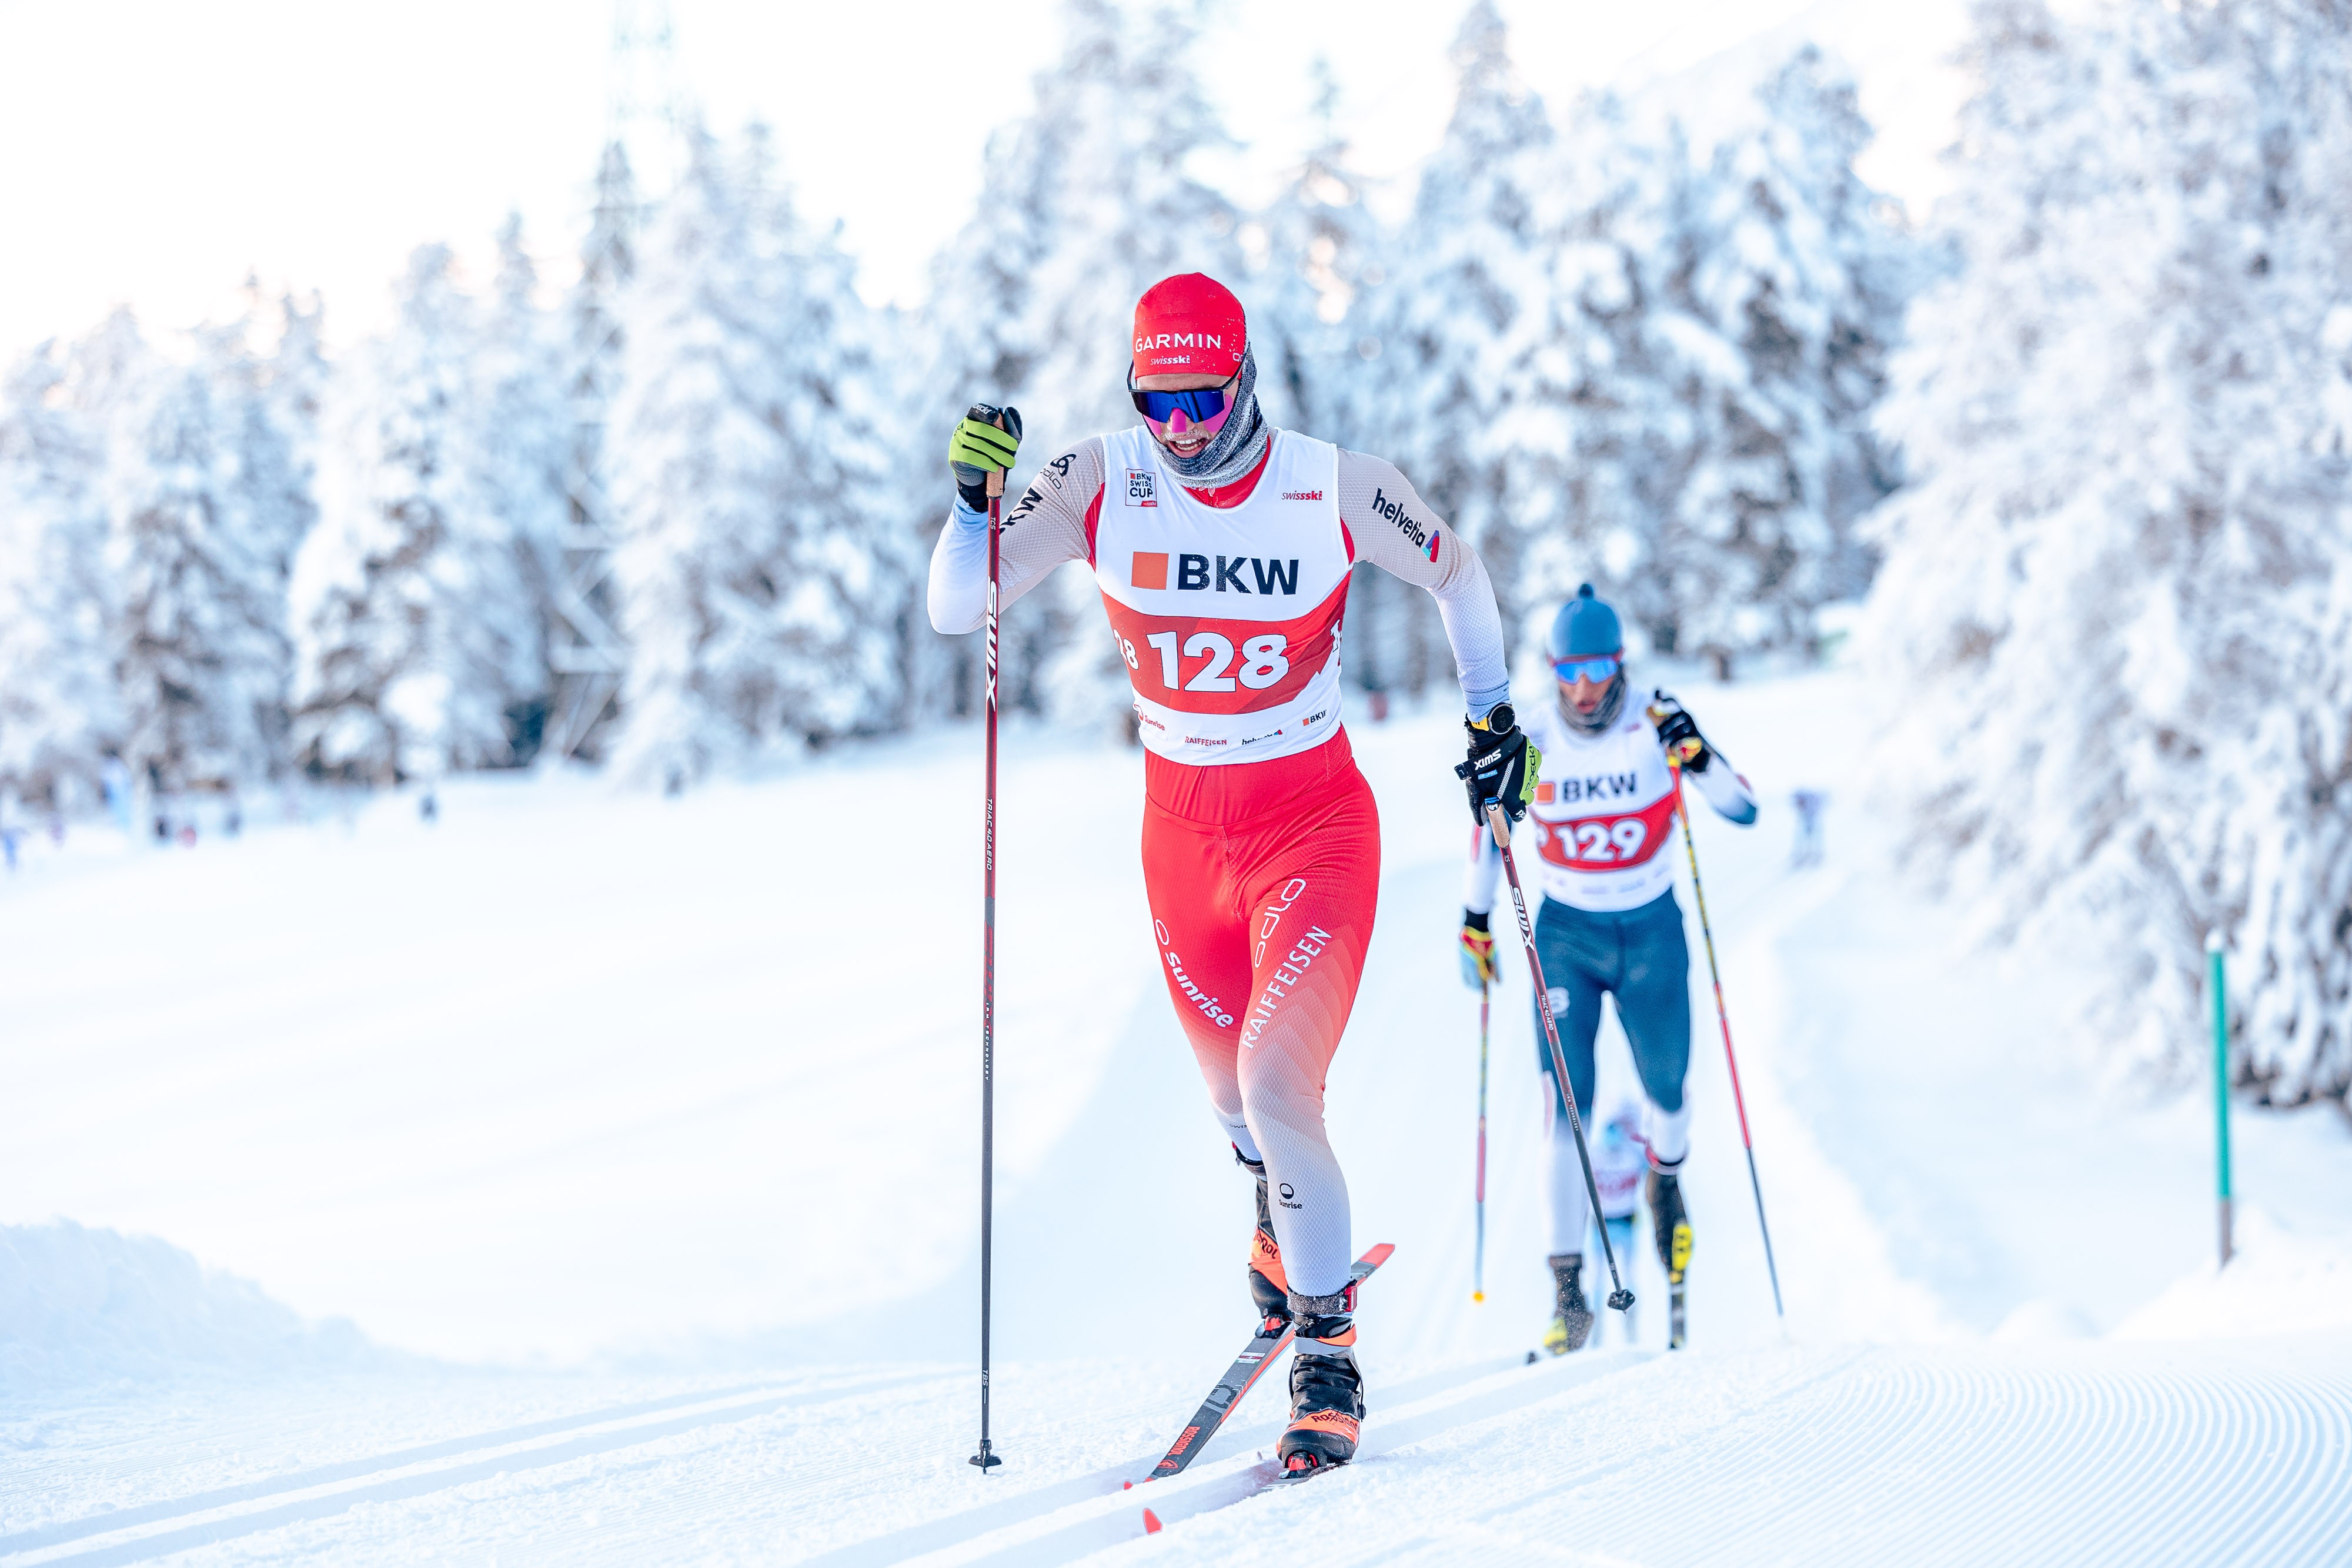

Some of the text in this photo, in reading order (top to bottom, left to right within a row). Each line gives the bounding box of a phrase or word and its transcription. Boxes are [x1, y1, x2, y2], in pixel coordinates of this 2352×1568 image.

[1135, 333, 1221, 353] GARMIN
[1130, 480, 1152, 488] SWISS
[1137, 473, 1151, 482] BKW
[1130, 487, 1154, 498] CUP
[1372, 487, 1425, 548] helvetia
[1178, 553, 1299, 595] BKW
[1146, 630, 1290, 693] 128
[1144, 715, 1165, 731] Sunrise
[1561, 771, 1636, 803] BKW
[1555, 818, 1646, 861] 129
[1242, 925, 1332, 1049] RAIFFEISEN
[1279, 1199, 1303, 1209] Sunrise
